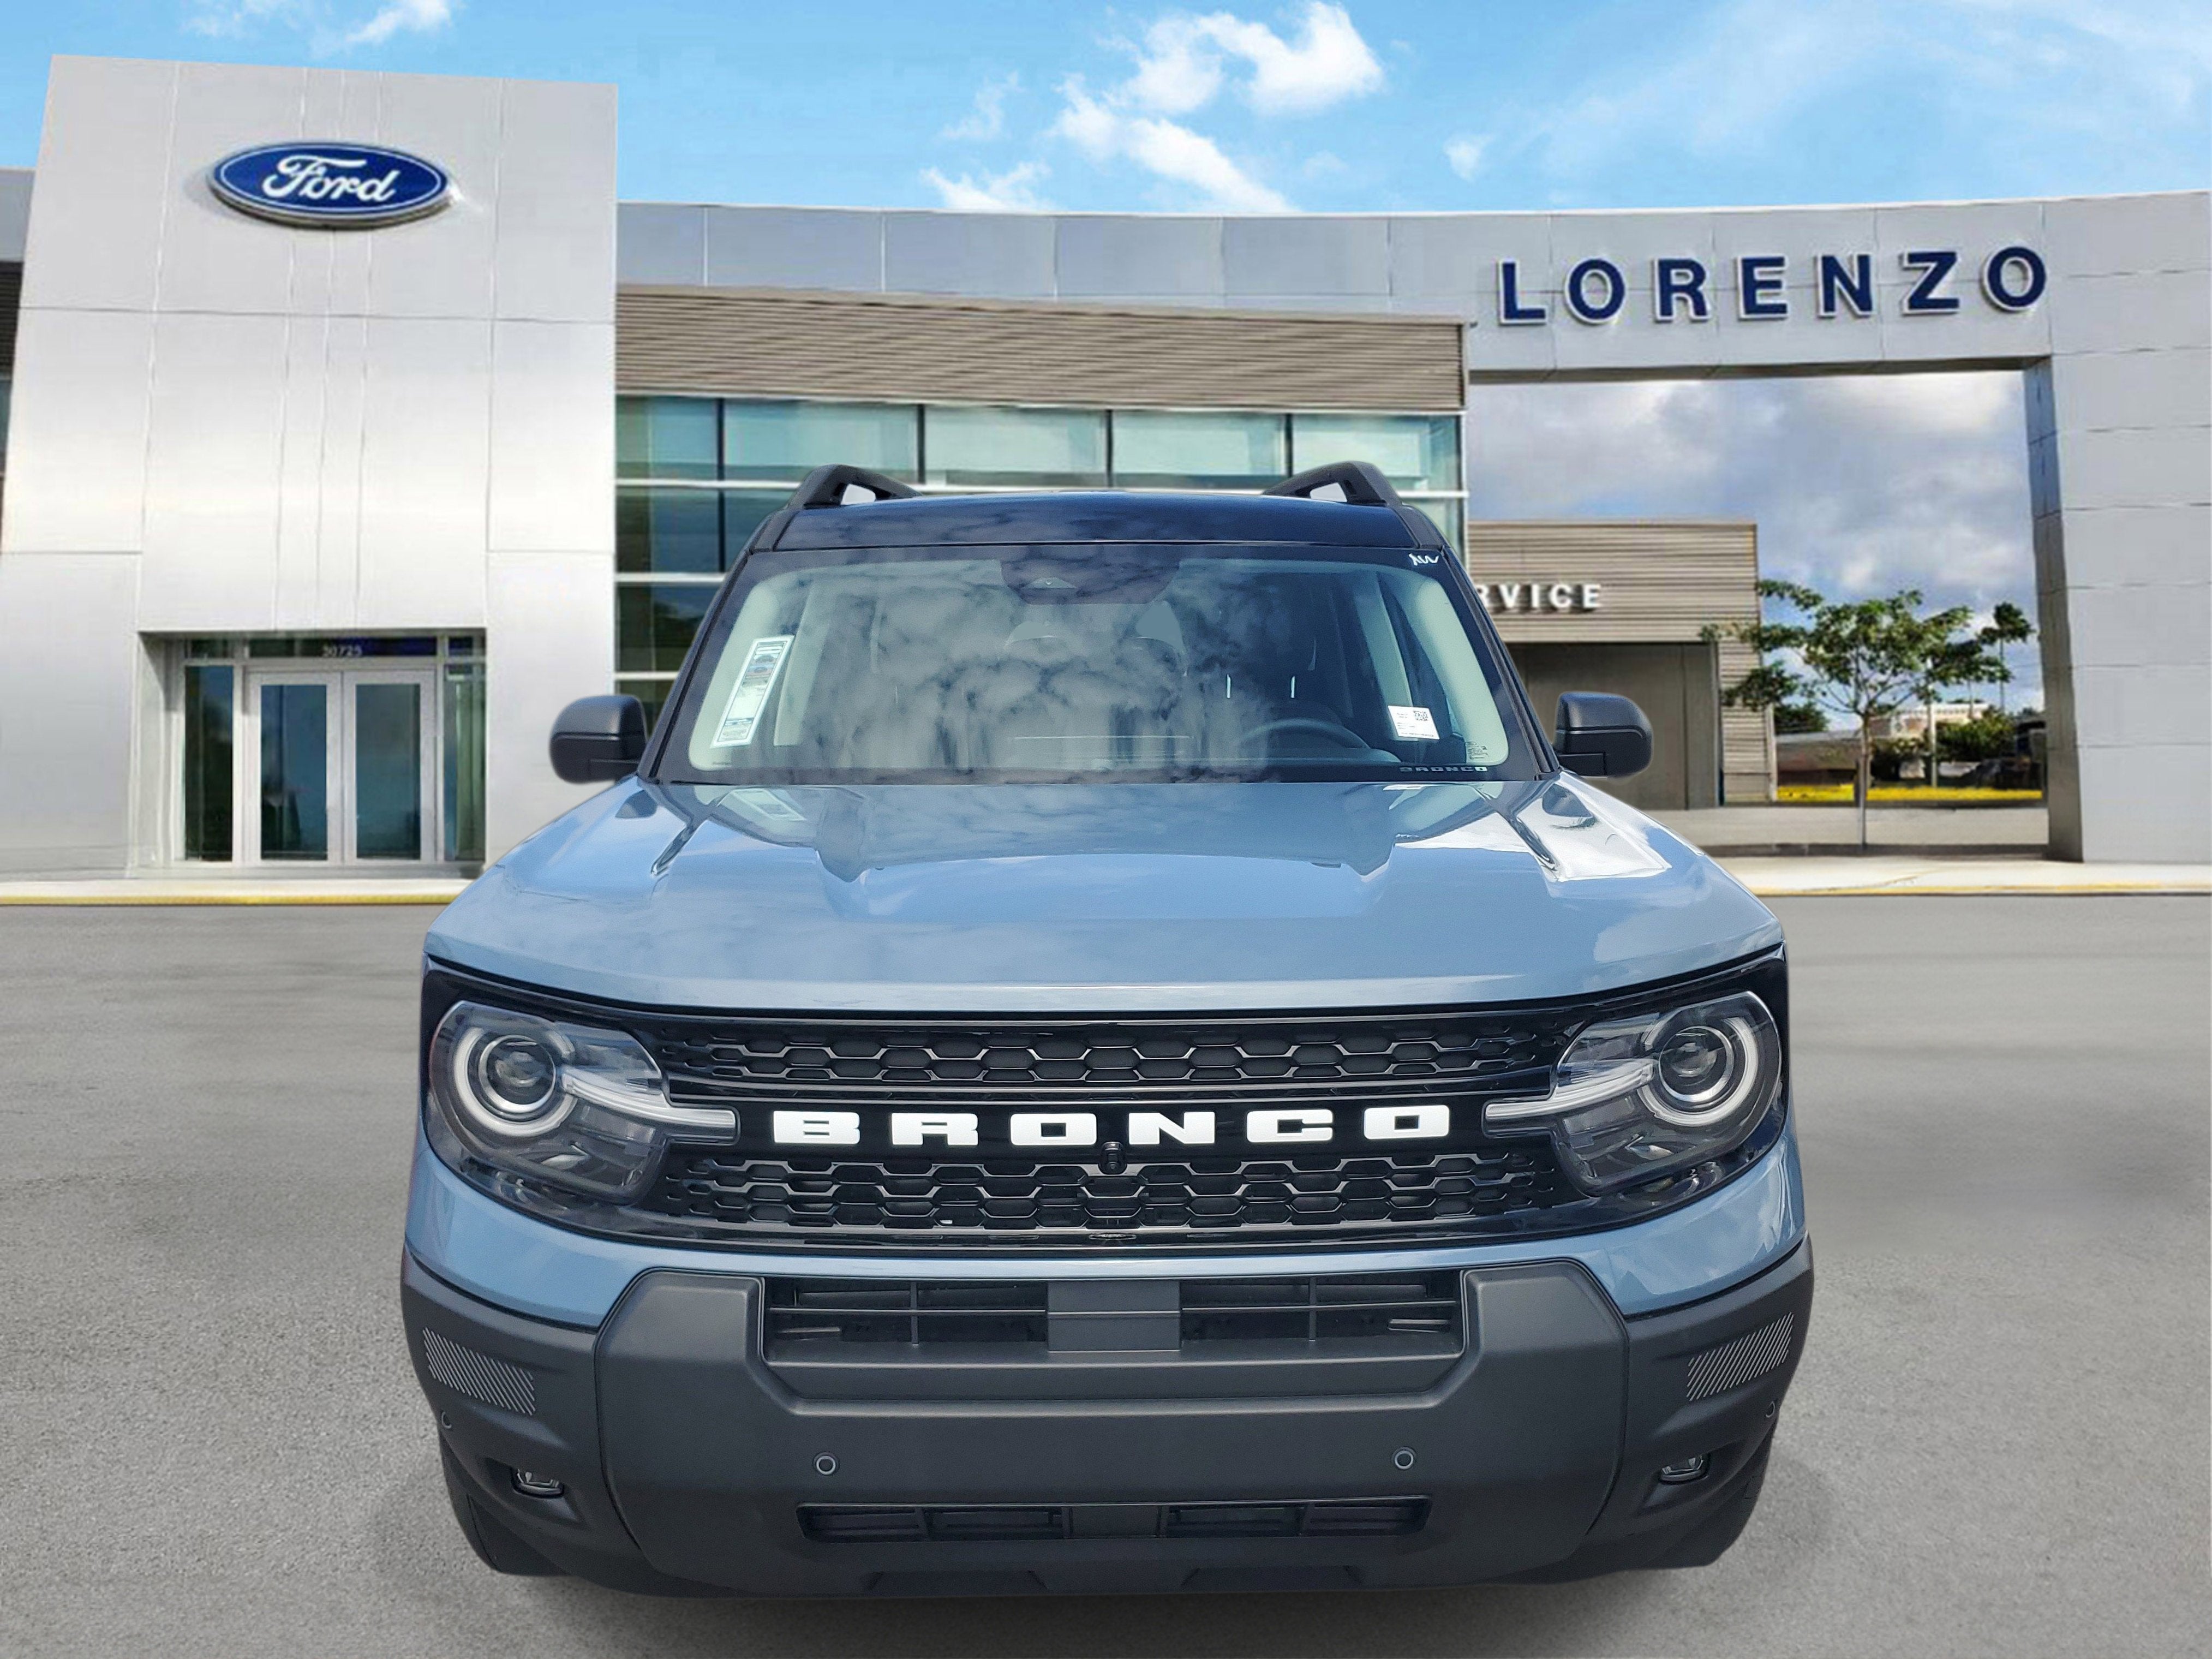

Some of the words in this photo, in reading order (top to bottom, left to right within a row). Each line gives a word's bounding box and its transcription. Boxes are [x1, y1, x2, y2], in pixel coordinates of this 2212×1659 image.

[262, 154, 399, 201] Ford
[1498, 246, 2047, 324] LORENZO
[772, 1104, 1450, 1145] BRONCO
